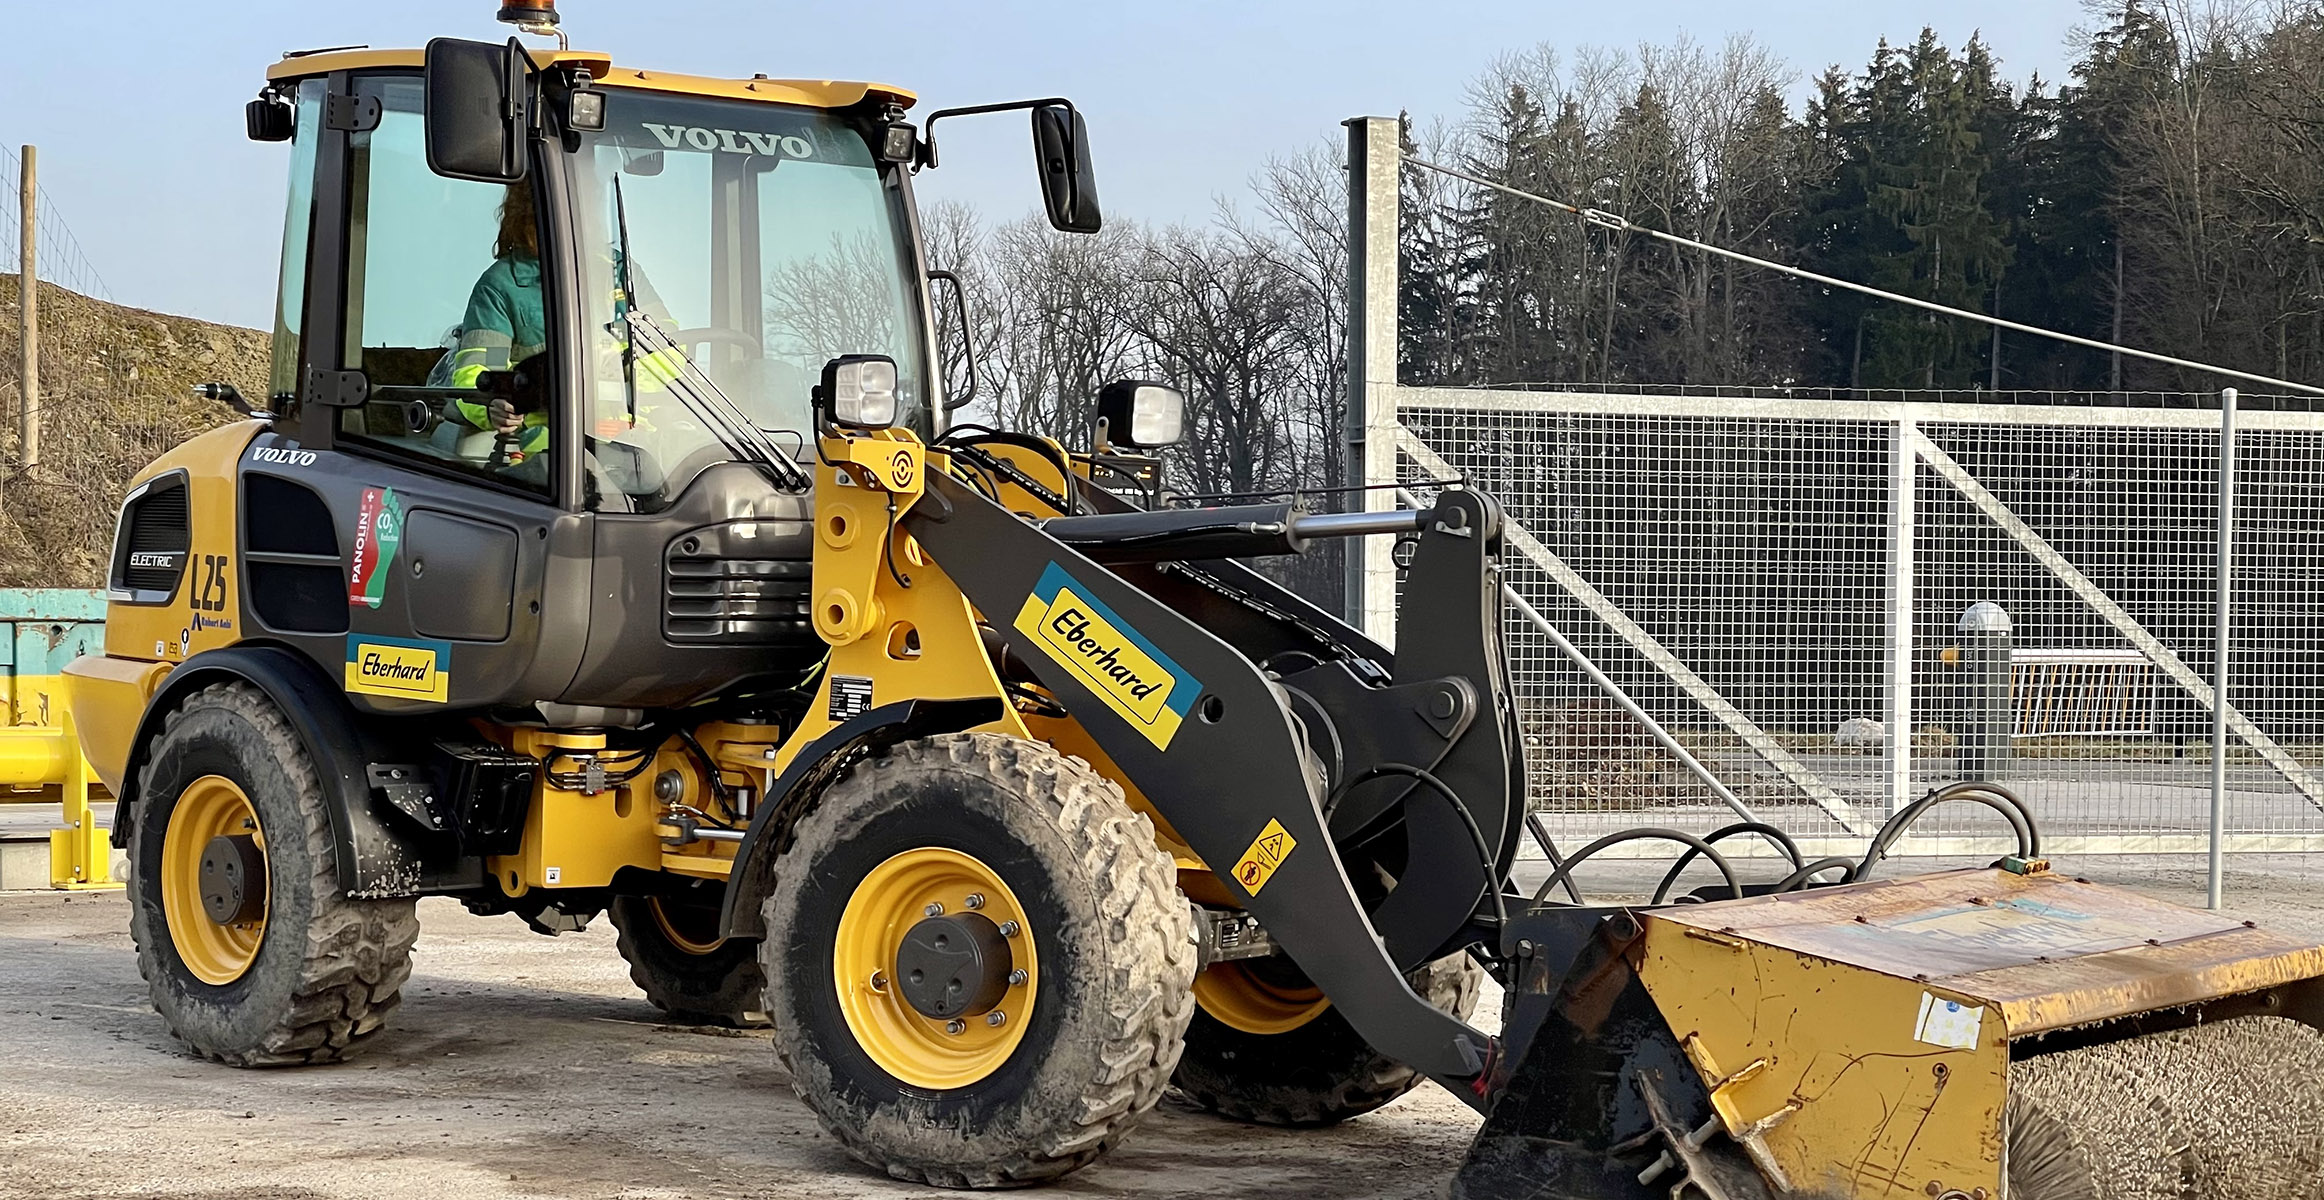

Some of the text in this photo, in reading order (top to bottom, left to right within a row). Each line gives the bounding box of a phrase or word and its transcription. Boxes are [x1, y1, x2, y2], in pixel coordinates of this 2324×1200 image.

[642, 123, 813, 159] VOLVO
[252, 447, 317, 466] VOLVO
[130, 554, 173, 568] ELECTRIC
[352, 512, 369, 583] PANOLIN
[190, 553, 228, 612] L25
[362, 652, 430, 681] Eberhard
[1051, 608, 1163, 702] Eberhard
